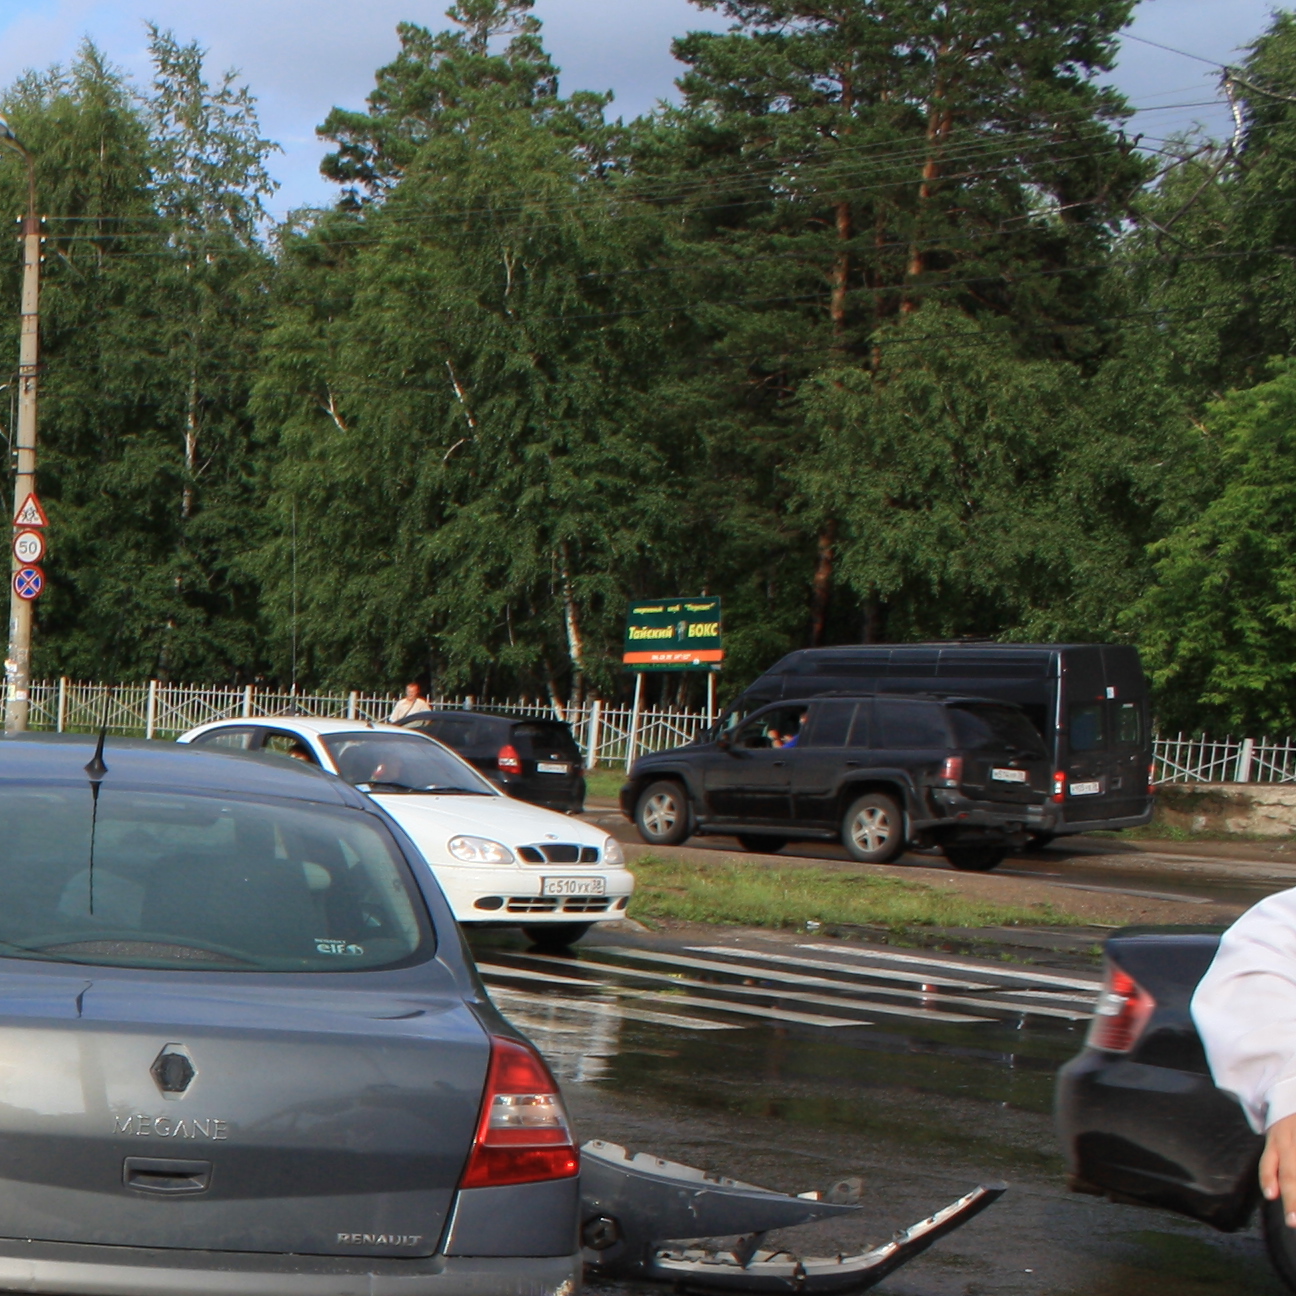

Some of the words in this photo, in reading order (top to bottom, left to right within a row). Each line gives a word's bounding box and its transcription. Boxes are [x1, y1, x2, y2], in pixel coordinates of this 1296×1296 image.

[19, 541, 37, 554] 50
[629, 625, 673, 639] Тайский
[688, 622, 718, 638] БОКС
[112, 1114, 228, 1140] MEGANE
[337, 1232, 422, 1247] RENAULT
